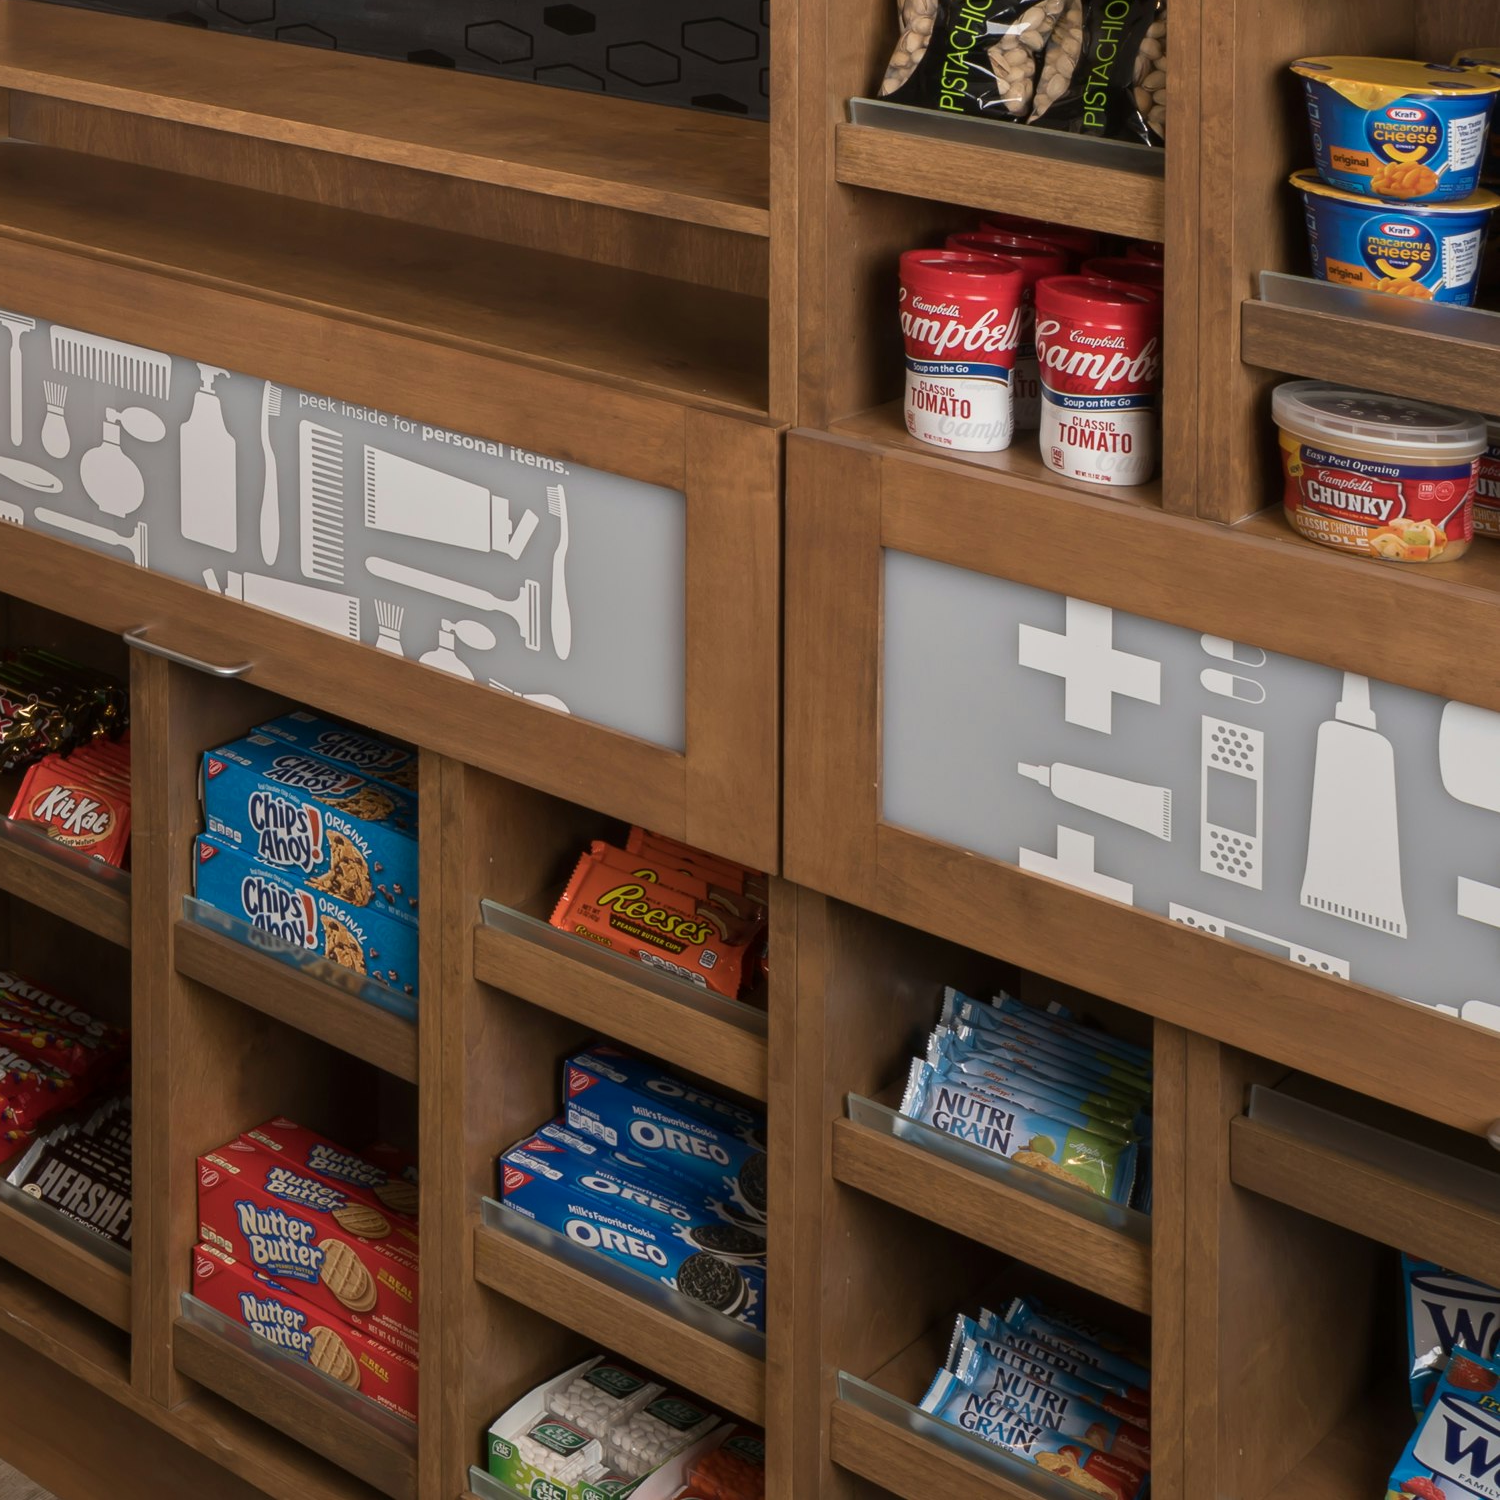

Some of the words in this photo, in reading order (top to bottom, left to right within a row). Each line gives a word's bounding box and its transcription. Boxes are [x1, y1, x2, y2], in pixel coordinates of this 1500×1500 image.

[1374, 122, 1428, 133] macaroni
[1333, 154, 1369, 168] original
[1368, 237, 1422, 249] macaroni
[1388, 226, 1411, 235] Kraft
[1329, 267, 1362, 281] original
[912, 296, 961, 317] Campbell's
[1069, 329, 1125, 349] Campbell's
[913, 363, 926, 373] Soup
[955, 365, 969, 373] Go
[912, 387, 971, 418] TOMATO
[920, 381, 955, 397] CLASSIC
[1064, 397, 1084, 408] Soup
[1086, 399, 1098, 408] on
[1100, 398, 1116, 407] the
[1117, 398, 1130, 406] Go
[300, 392, 336, 413] peek
[342, 401, 388, 426] inside
[392, 416, 417, 434] for
[422, 426, 503, 458] personal
[510, 446, 570, 476] items.
[1059, 423, 1132, 453] TOMATO
[1072, 416, 1115, 432] CLASSIC
[1306, 449, 1326, 462] Easy
[1329, 454, 1349, 468] Peel
[1352, 461, 1399, 477] Opening
[1319, 470, 1373, 493] Campbell's
[1308, 480, 1394, 521] CHUNKY
[1297, 515, 1329, 531] CLASSIC
[1330, 522, 1367, 536] CHICKEN
[1301, 528, 1368, 546] NOODLE
[250, 792, 308, 836] Chips
[258, 804, 323, 873] Ahoy!
[325, 812, 373, 859] ORIGINAL
[242, 876, 301, 920] Chips
[599, 883, 713, 945] Reese's
[319, 898, 368, 944] ORIGINAL
[617, 921, 640, 935] PEANUT
[641, 930, 664, 945] BUTTER
[632, 1106, 655, 1120] Milk's
[656, 1113, 690, 1131] Favorite
[691, 1124, 718, 1140] Cookie
[935, 1087, 1015, 1132] NUTRI
[629, 1120, 730, 1166] OREO
[932, 1112, 1012, 1155] GRAIN
[580, 1176, 692, 1220] OREO
[237, 1202, 314, 1242] Nutter
[568, 1204, 592, 1218] Milk's
[593, 1211, 626, 1229] Favorite
[627, 1222, 655, 1240] Cookie
[250, 1235, 325, 1271] Butter
[564, 1219, 668, 1267] OREO
[241, 1296, 304, 1329] Nutter
[993, 1367, 1069, 1415] NUTRI
[959, 1411, 1038, 1454] GRAIN
